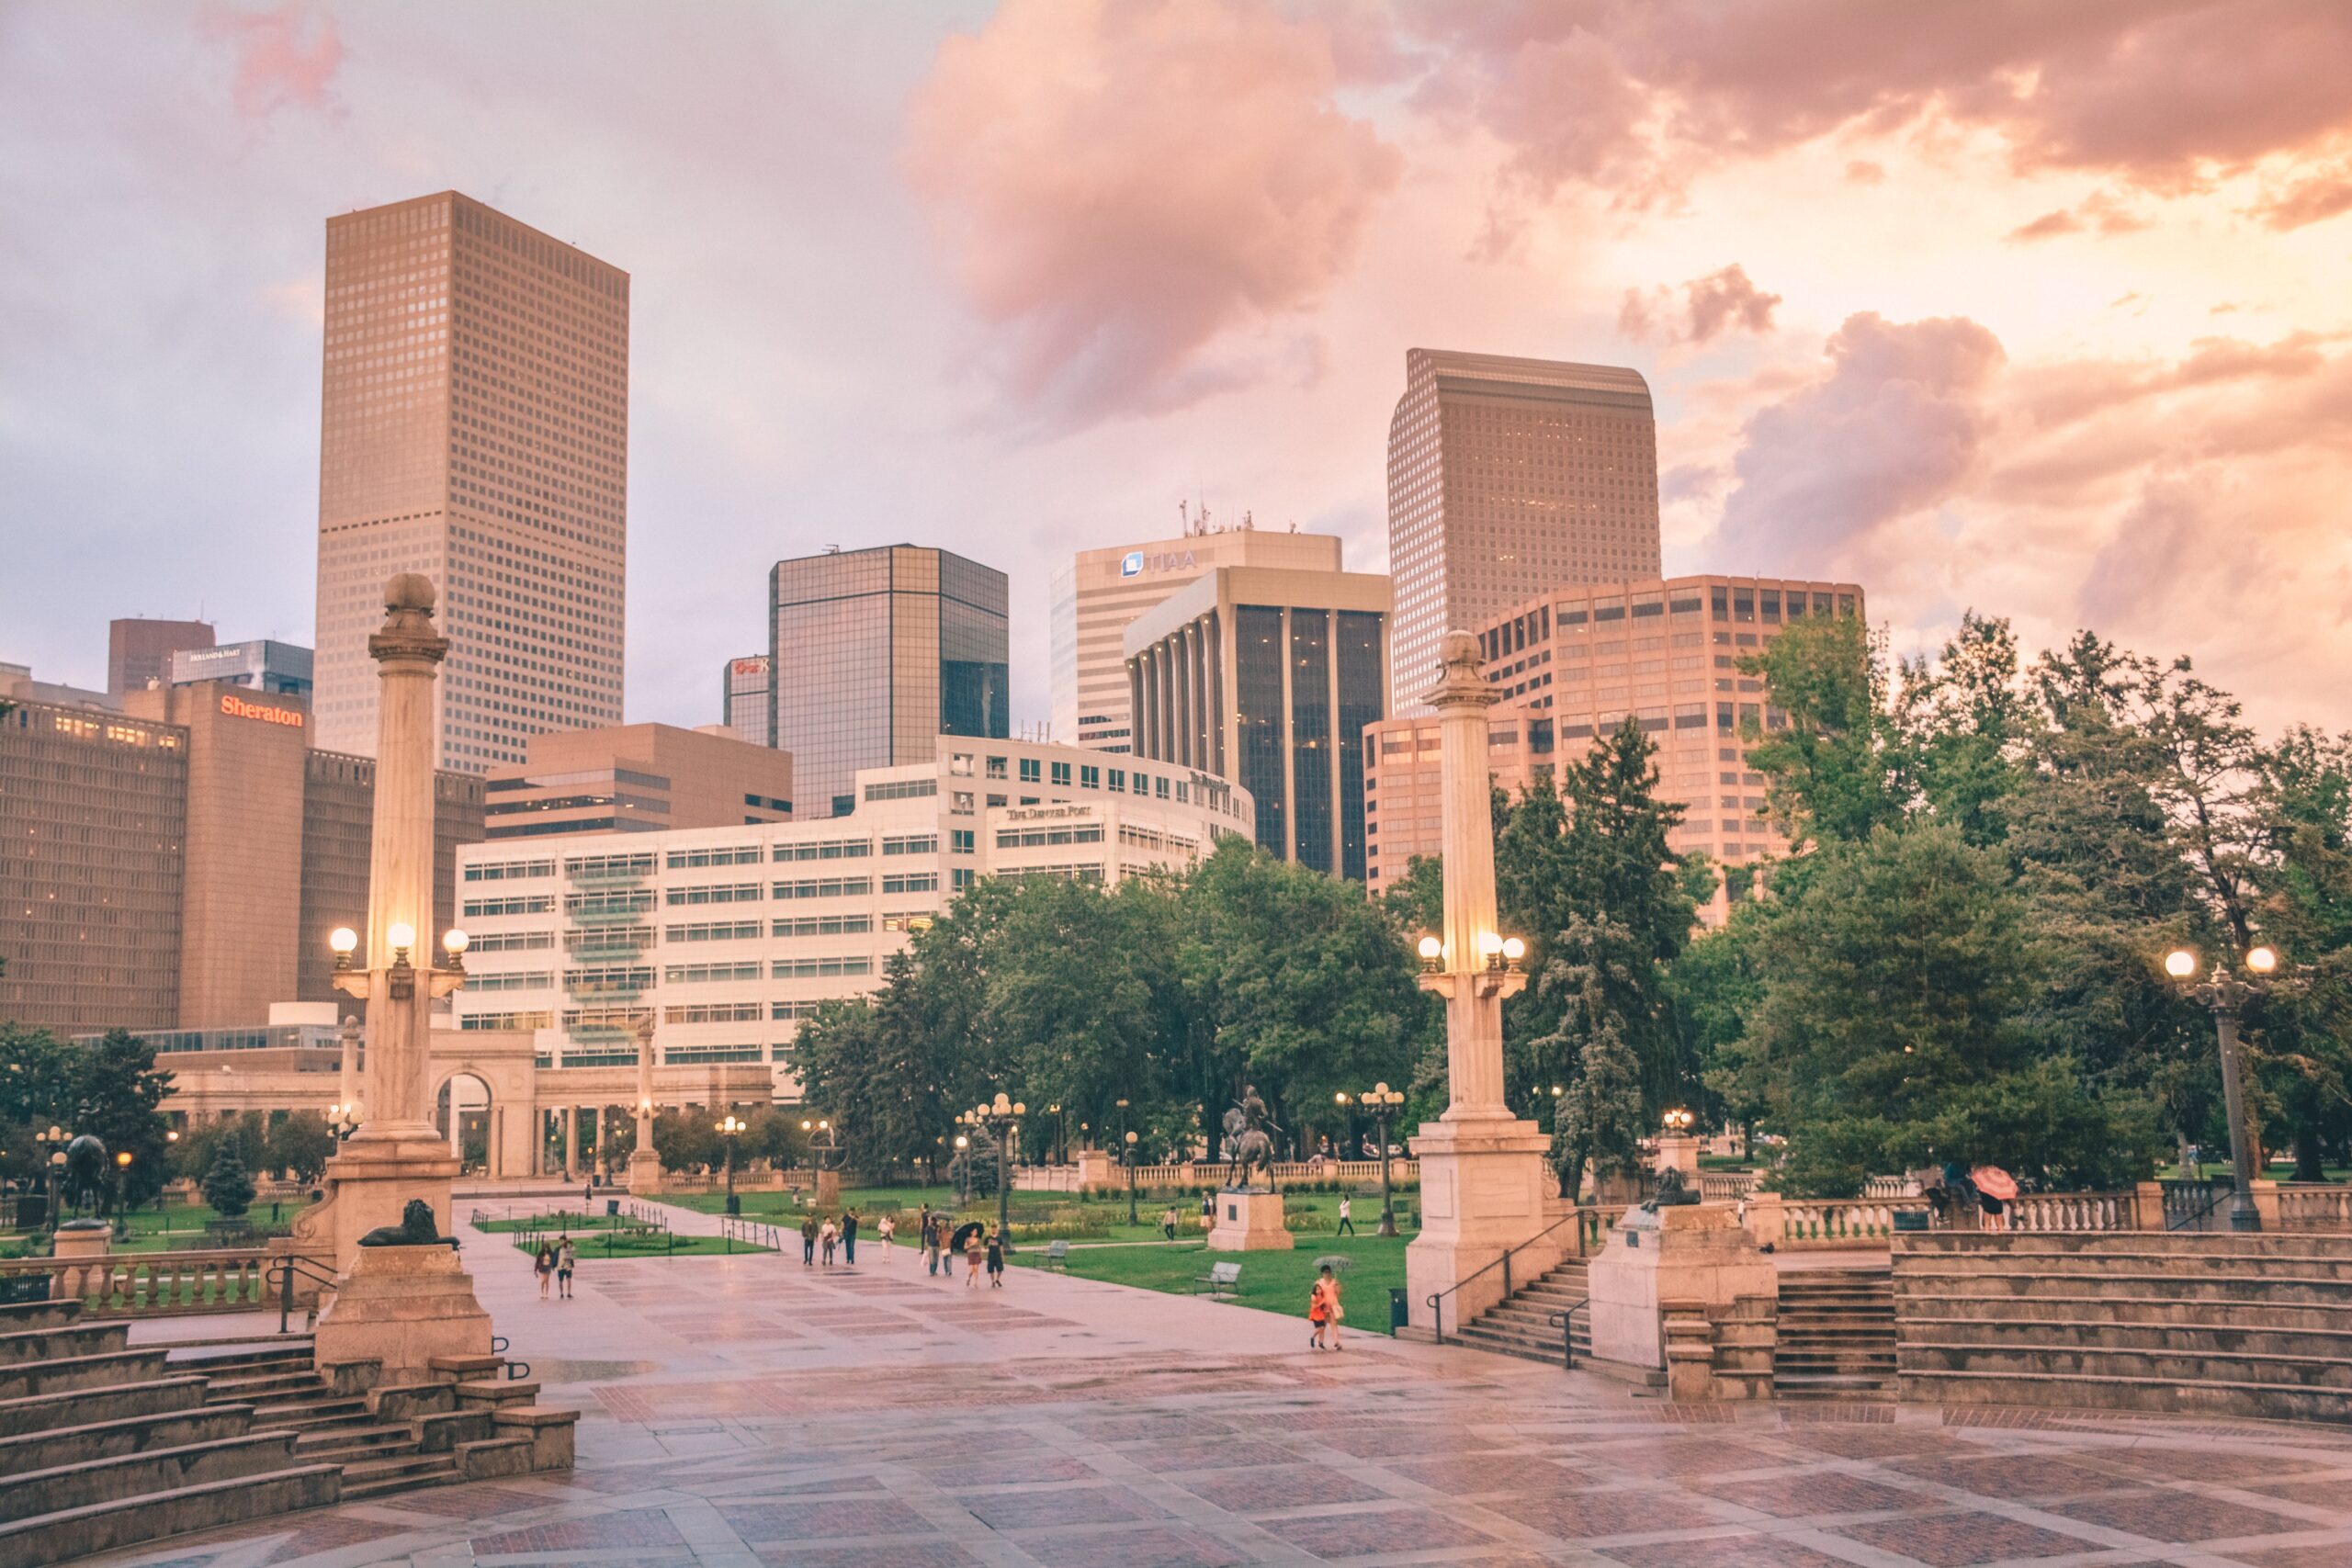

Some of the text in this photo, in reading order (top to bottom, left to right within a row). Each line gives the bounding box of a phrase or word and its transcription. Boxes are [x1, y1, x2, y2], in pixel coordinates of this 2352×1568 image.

[1146, 551, 1197, 573] TIAA
[221, 695, 302, 727] Sheraton
[1007, 806, 1091, 820] THE DENVER POST
